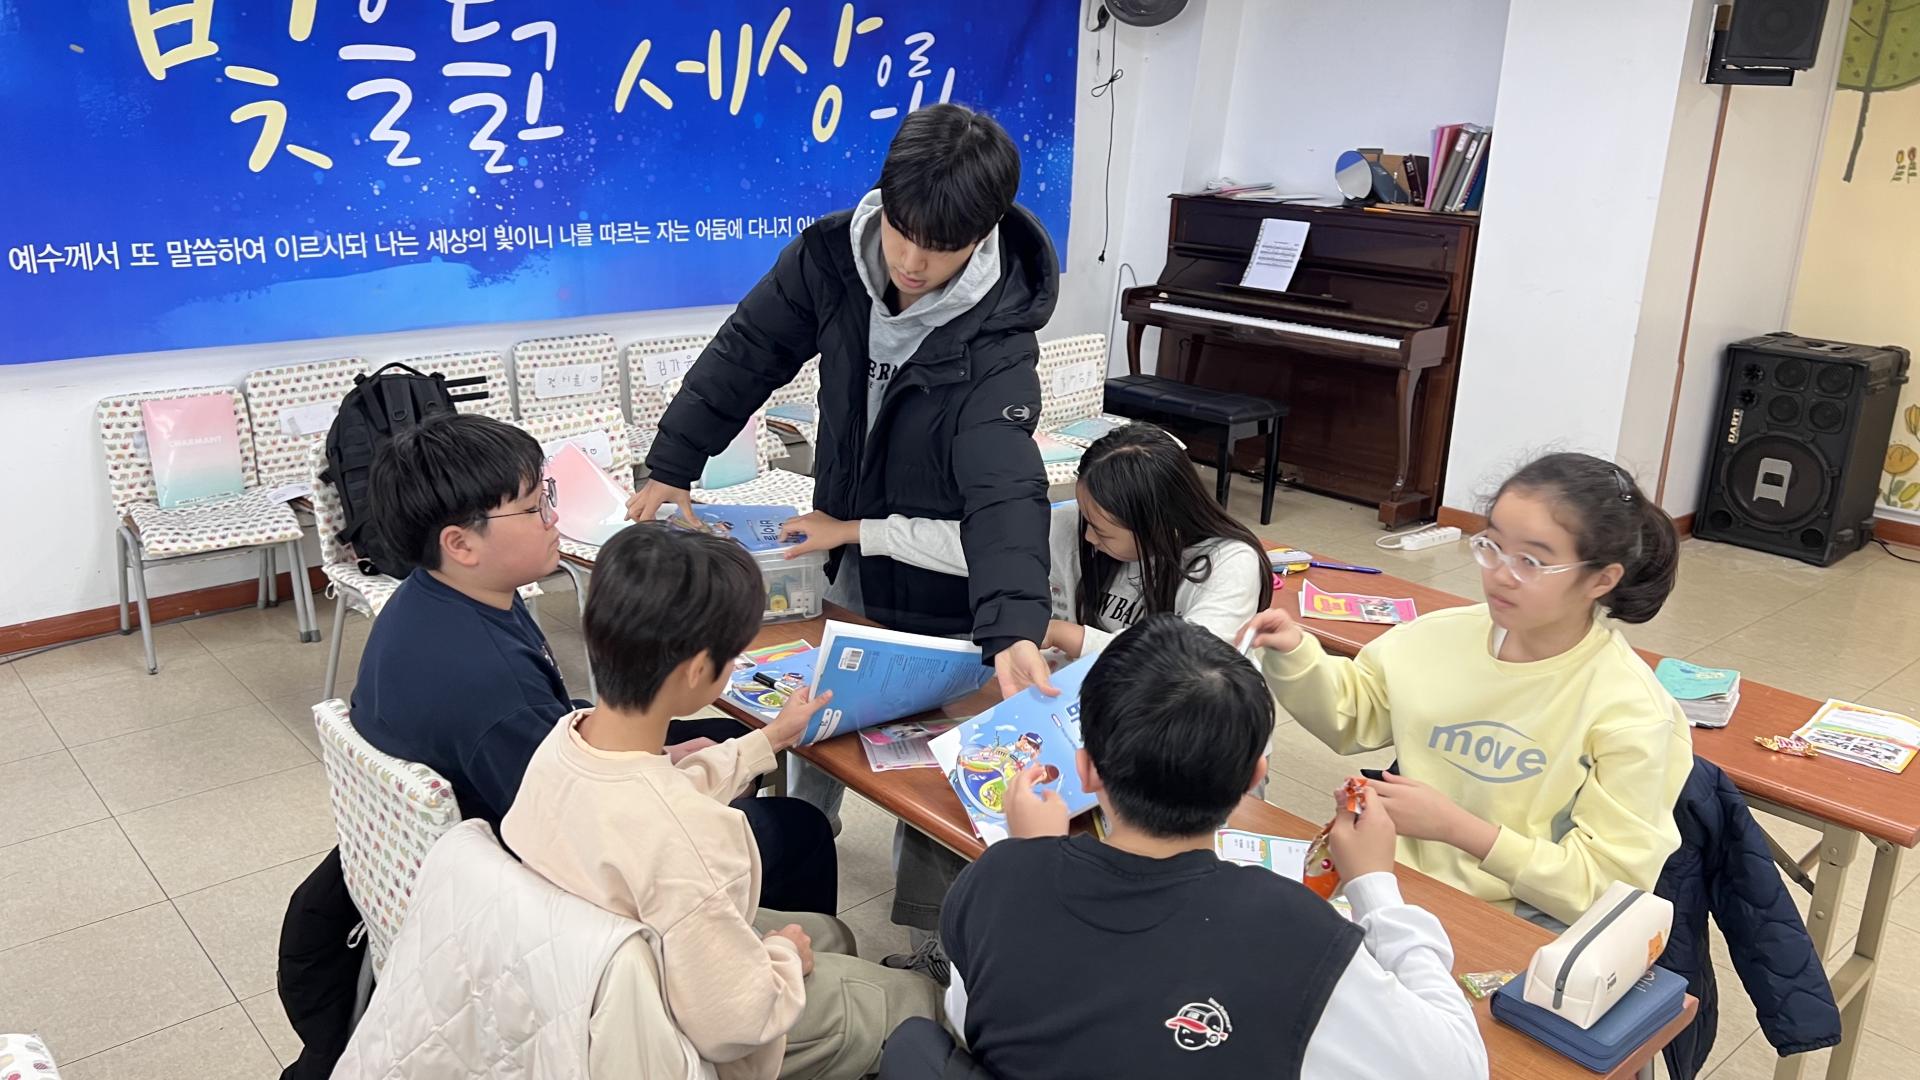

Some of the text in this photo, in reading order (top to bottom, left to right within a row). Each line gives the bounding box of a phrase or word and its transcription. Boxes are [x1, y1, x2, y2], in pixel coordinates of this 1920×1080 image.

[128, 0, 333, 173] 빛
[441, 0, 565, 174] 들고
[8, 241, 120, 275] 예수께서
[130, 242, 160, 267] 또
[166, 236, 266, 268] 말씀하여
[275, 231, 367, 262] 이르시되
[374, 230, 420, 257] 나는
[426, 227, 487, 255] 세상의
[494, 225, 553, 251] 빛이니
[559, 223, 594, 248] 나를
[599, 221, 651, 246] 따르는
[656, 220, 690, 244] 자는
[695, 217, 743, 242] 어둠에
[748, 216, 792, 240] 다니지
[1727, 408, 1741, 444] DART
[1427, 725, 1547, 776] move
